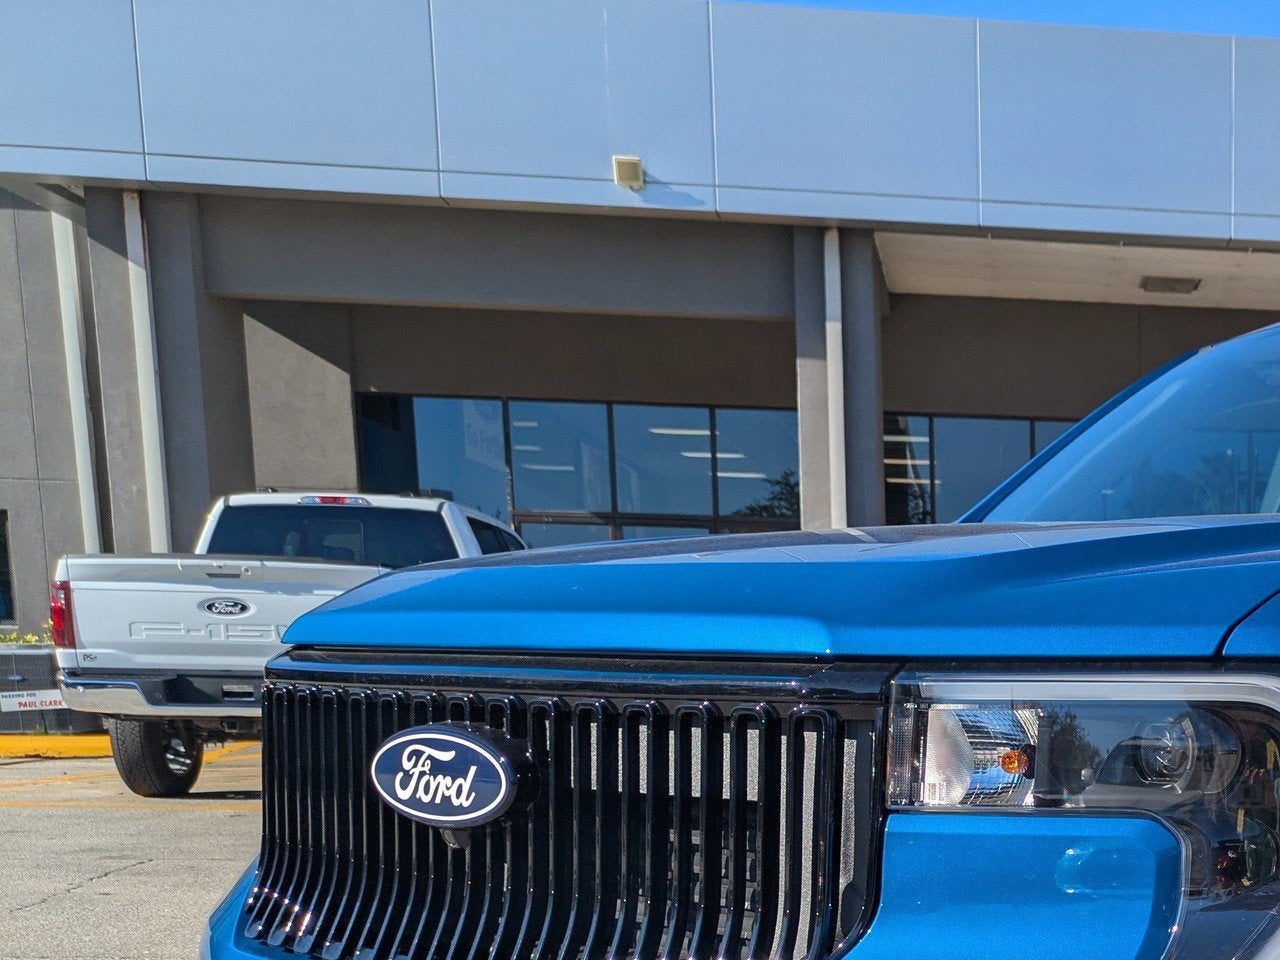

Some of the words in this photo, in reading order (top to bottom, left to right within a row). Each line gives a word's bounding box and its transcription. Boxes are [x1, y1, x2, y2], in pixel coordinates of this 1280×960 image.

[211, 600, 242, 614] Ford
[129, 621, 287, 642] F-15
[18, 701, 37, 709] PAUL
[395, 744, 477, 807] Ford
